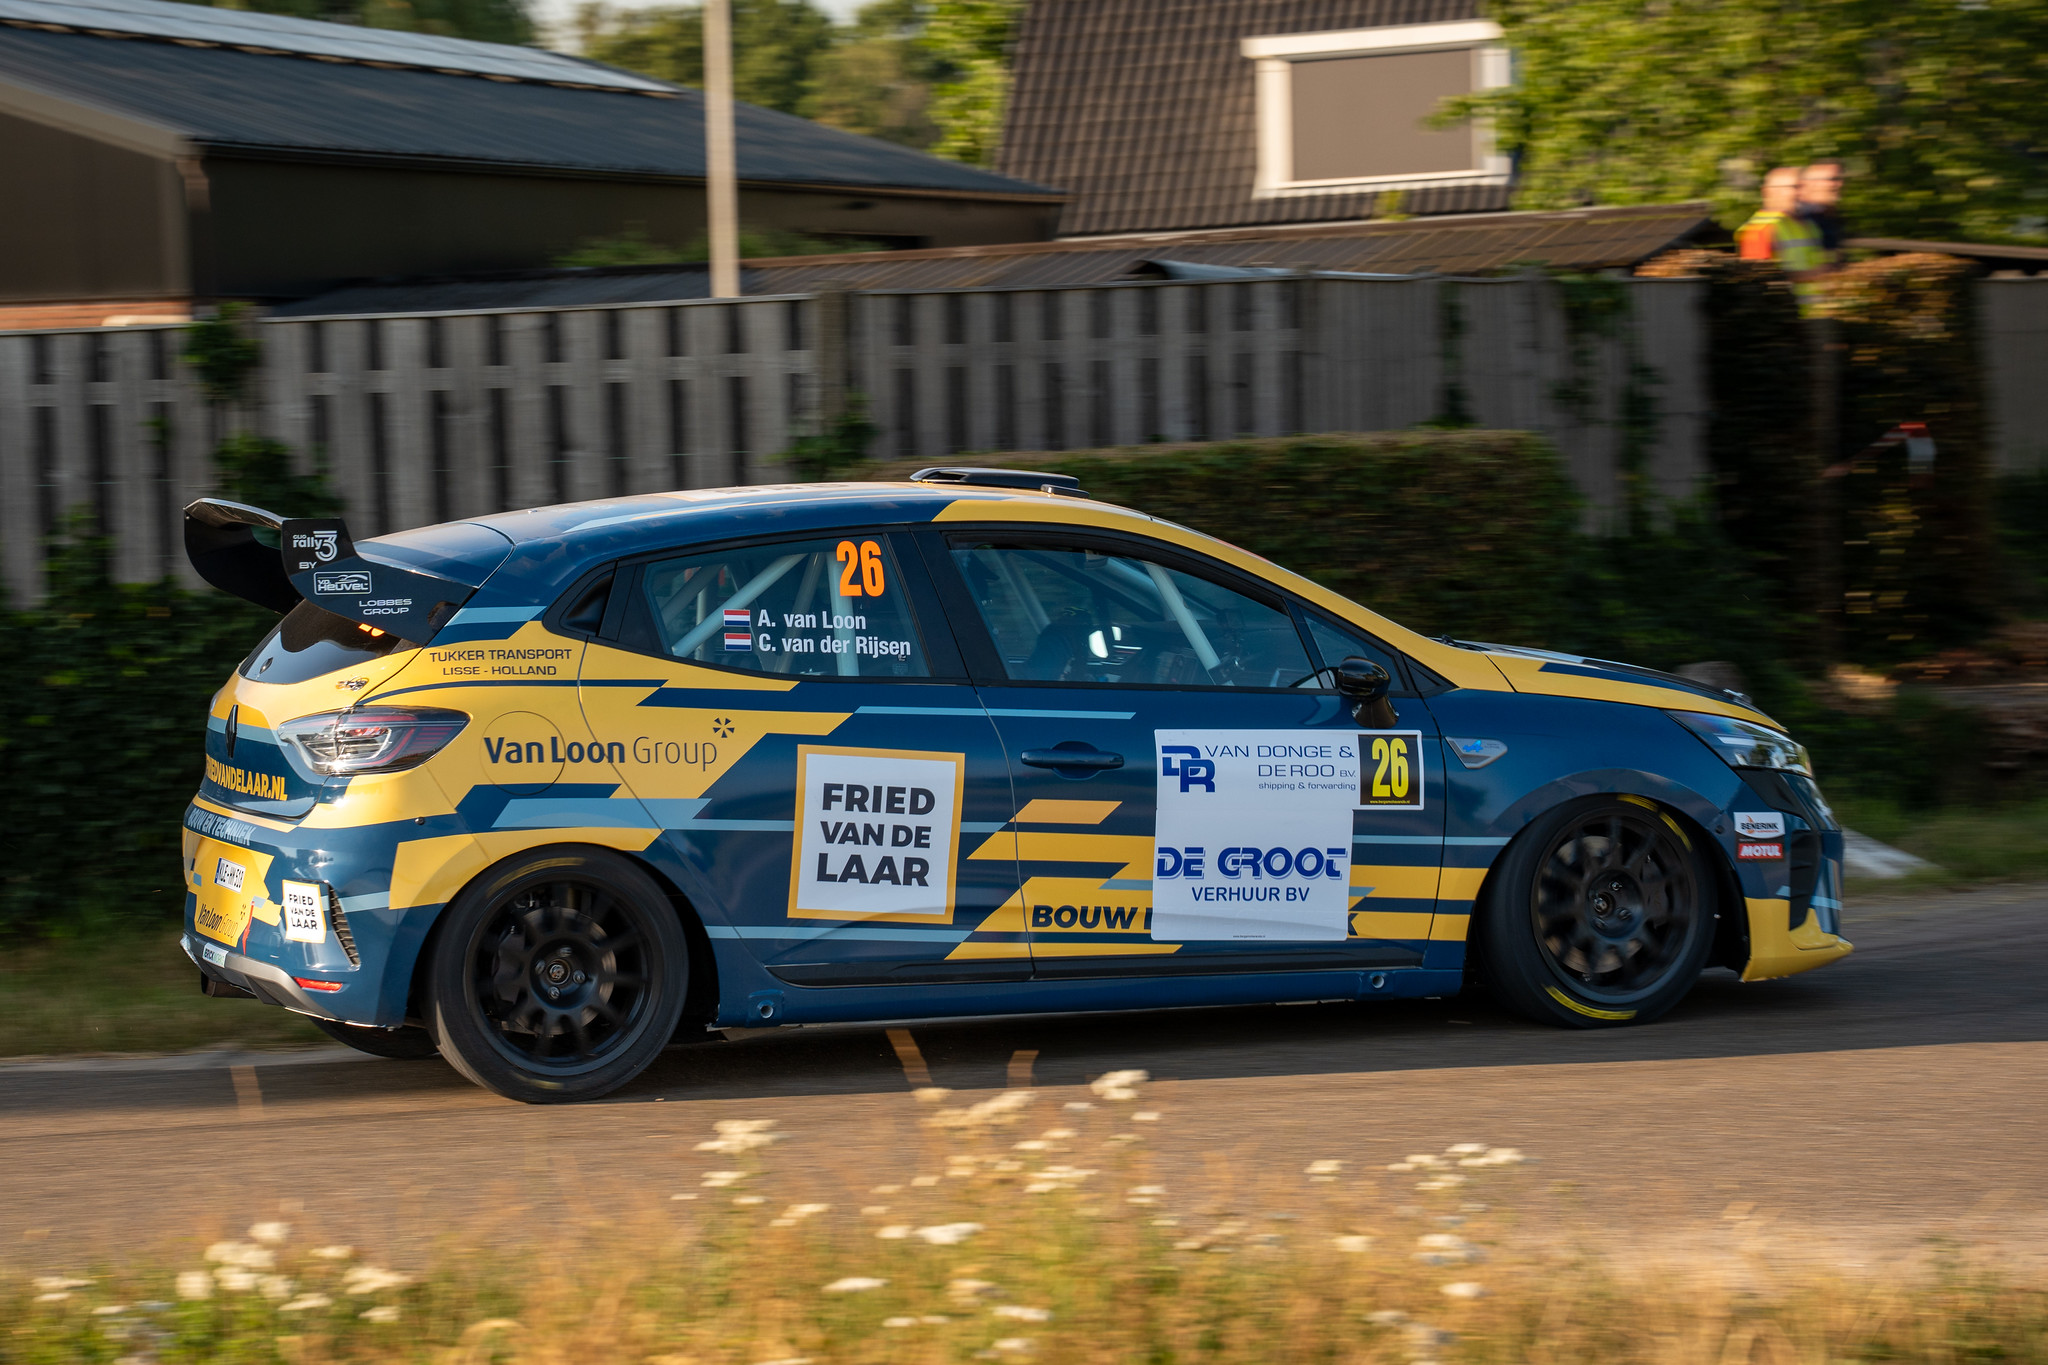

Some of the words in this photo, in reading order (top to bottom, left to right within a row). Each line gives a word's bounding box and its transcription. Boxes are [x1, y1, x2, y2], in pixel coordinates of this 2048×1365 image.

[298, 561, 317, 569] BY
[836, 540, 885, 597] 26
[359, 599, 412, 607] LOBBES
[363, 607, 410, 616] GROUP
[757, 609, 776, 628] A.
[783, 613, 817, 629] van
[822, 610, 867, 630] Loon
[758, 633, 776, 651] C.
[781, 637, 815, 653] van
[820, 635, 850, 655] der
[855, 636, 911, 659] Rijsen
[429, 650, 485, 663] TUKKER
[488, 649, 572, 661] TRANSPORT
[442, 666, 480, 676] LISSE
[491, 665, 557, 676] HOLLAND
[633, 736, 717, 772] Group
[1205, 745, 1250, 758] VAN
[1257, 745, 1332, 758] DONGE
[1339, 745, 1355, 758] &
[1371, 738, 1409, 798] 26
[206, 752, 288, 801] EDVANDELAAR.NL
[1258, 781, 1295, 791] shipping
[1298, 782, 1305, 790] &
[1307, 781, 1357, 791] forwarding
[822, 783, 936, 815] FRIED
[1740, 822, 1779, 830] BENERINK
[820, 820, 885, 847] VAN
[891, 824, 932, 849] DE
[1740, 845, 1782, 857] MOTUL
[816, 852, 930, 887] LAAR
[1157, 847, 1206, 880] DE
[1217, 847, 1348, 880] GROOT
[288, 893, 314, 906] FRIED
[1191, 887, 1280, 902] VERHUUR
[1286, 887, 1310, 902] BV
[290, 907, 304, 916] VAN
[305, 908, 316, 917] DE
[1031, 905, 1139, 930] BOUW
[291, 917, 318, 930] LAAR
